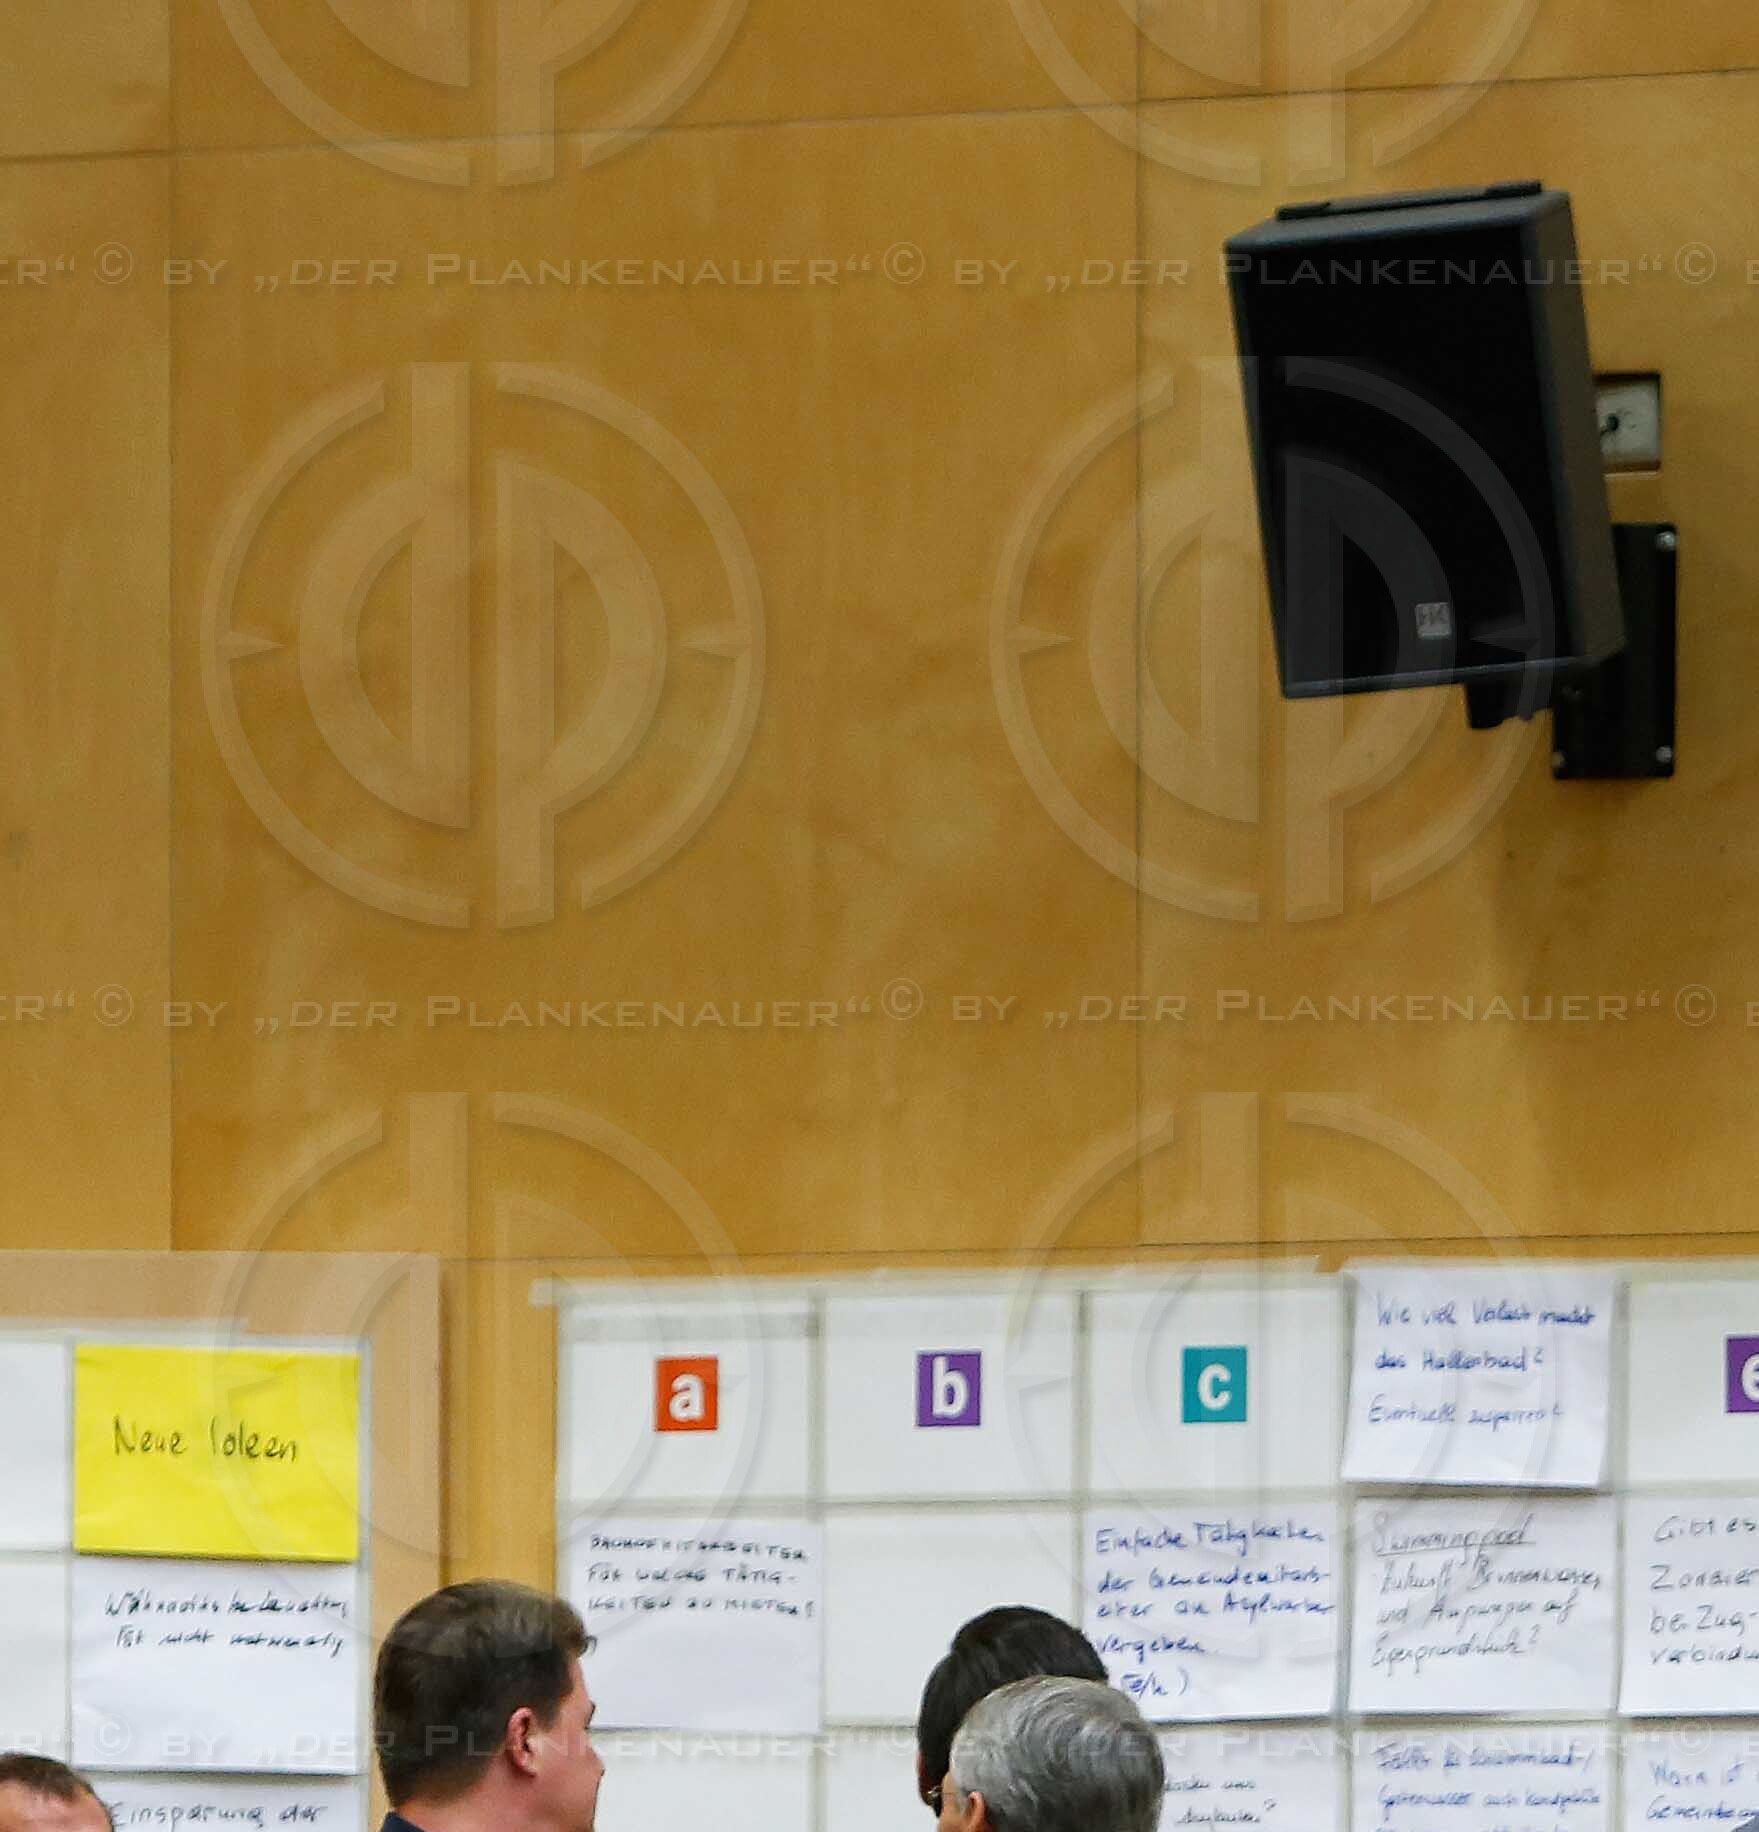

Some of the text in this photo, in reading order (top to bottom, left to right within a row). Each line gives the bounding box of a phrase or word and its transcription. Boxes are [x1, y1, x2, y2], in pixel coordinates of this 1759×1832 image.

[668, 1373, 706, 1421] a
[931, 1358, 969, 1417] b
[1197, 1363, 1233, 1410] c
[113, 1415, 298, 1463] Neue Ideen
